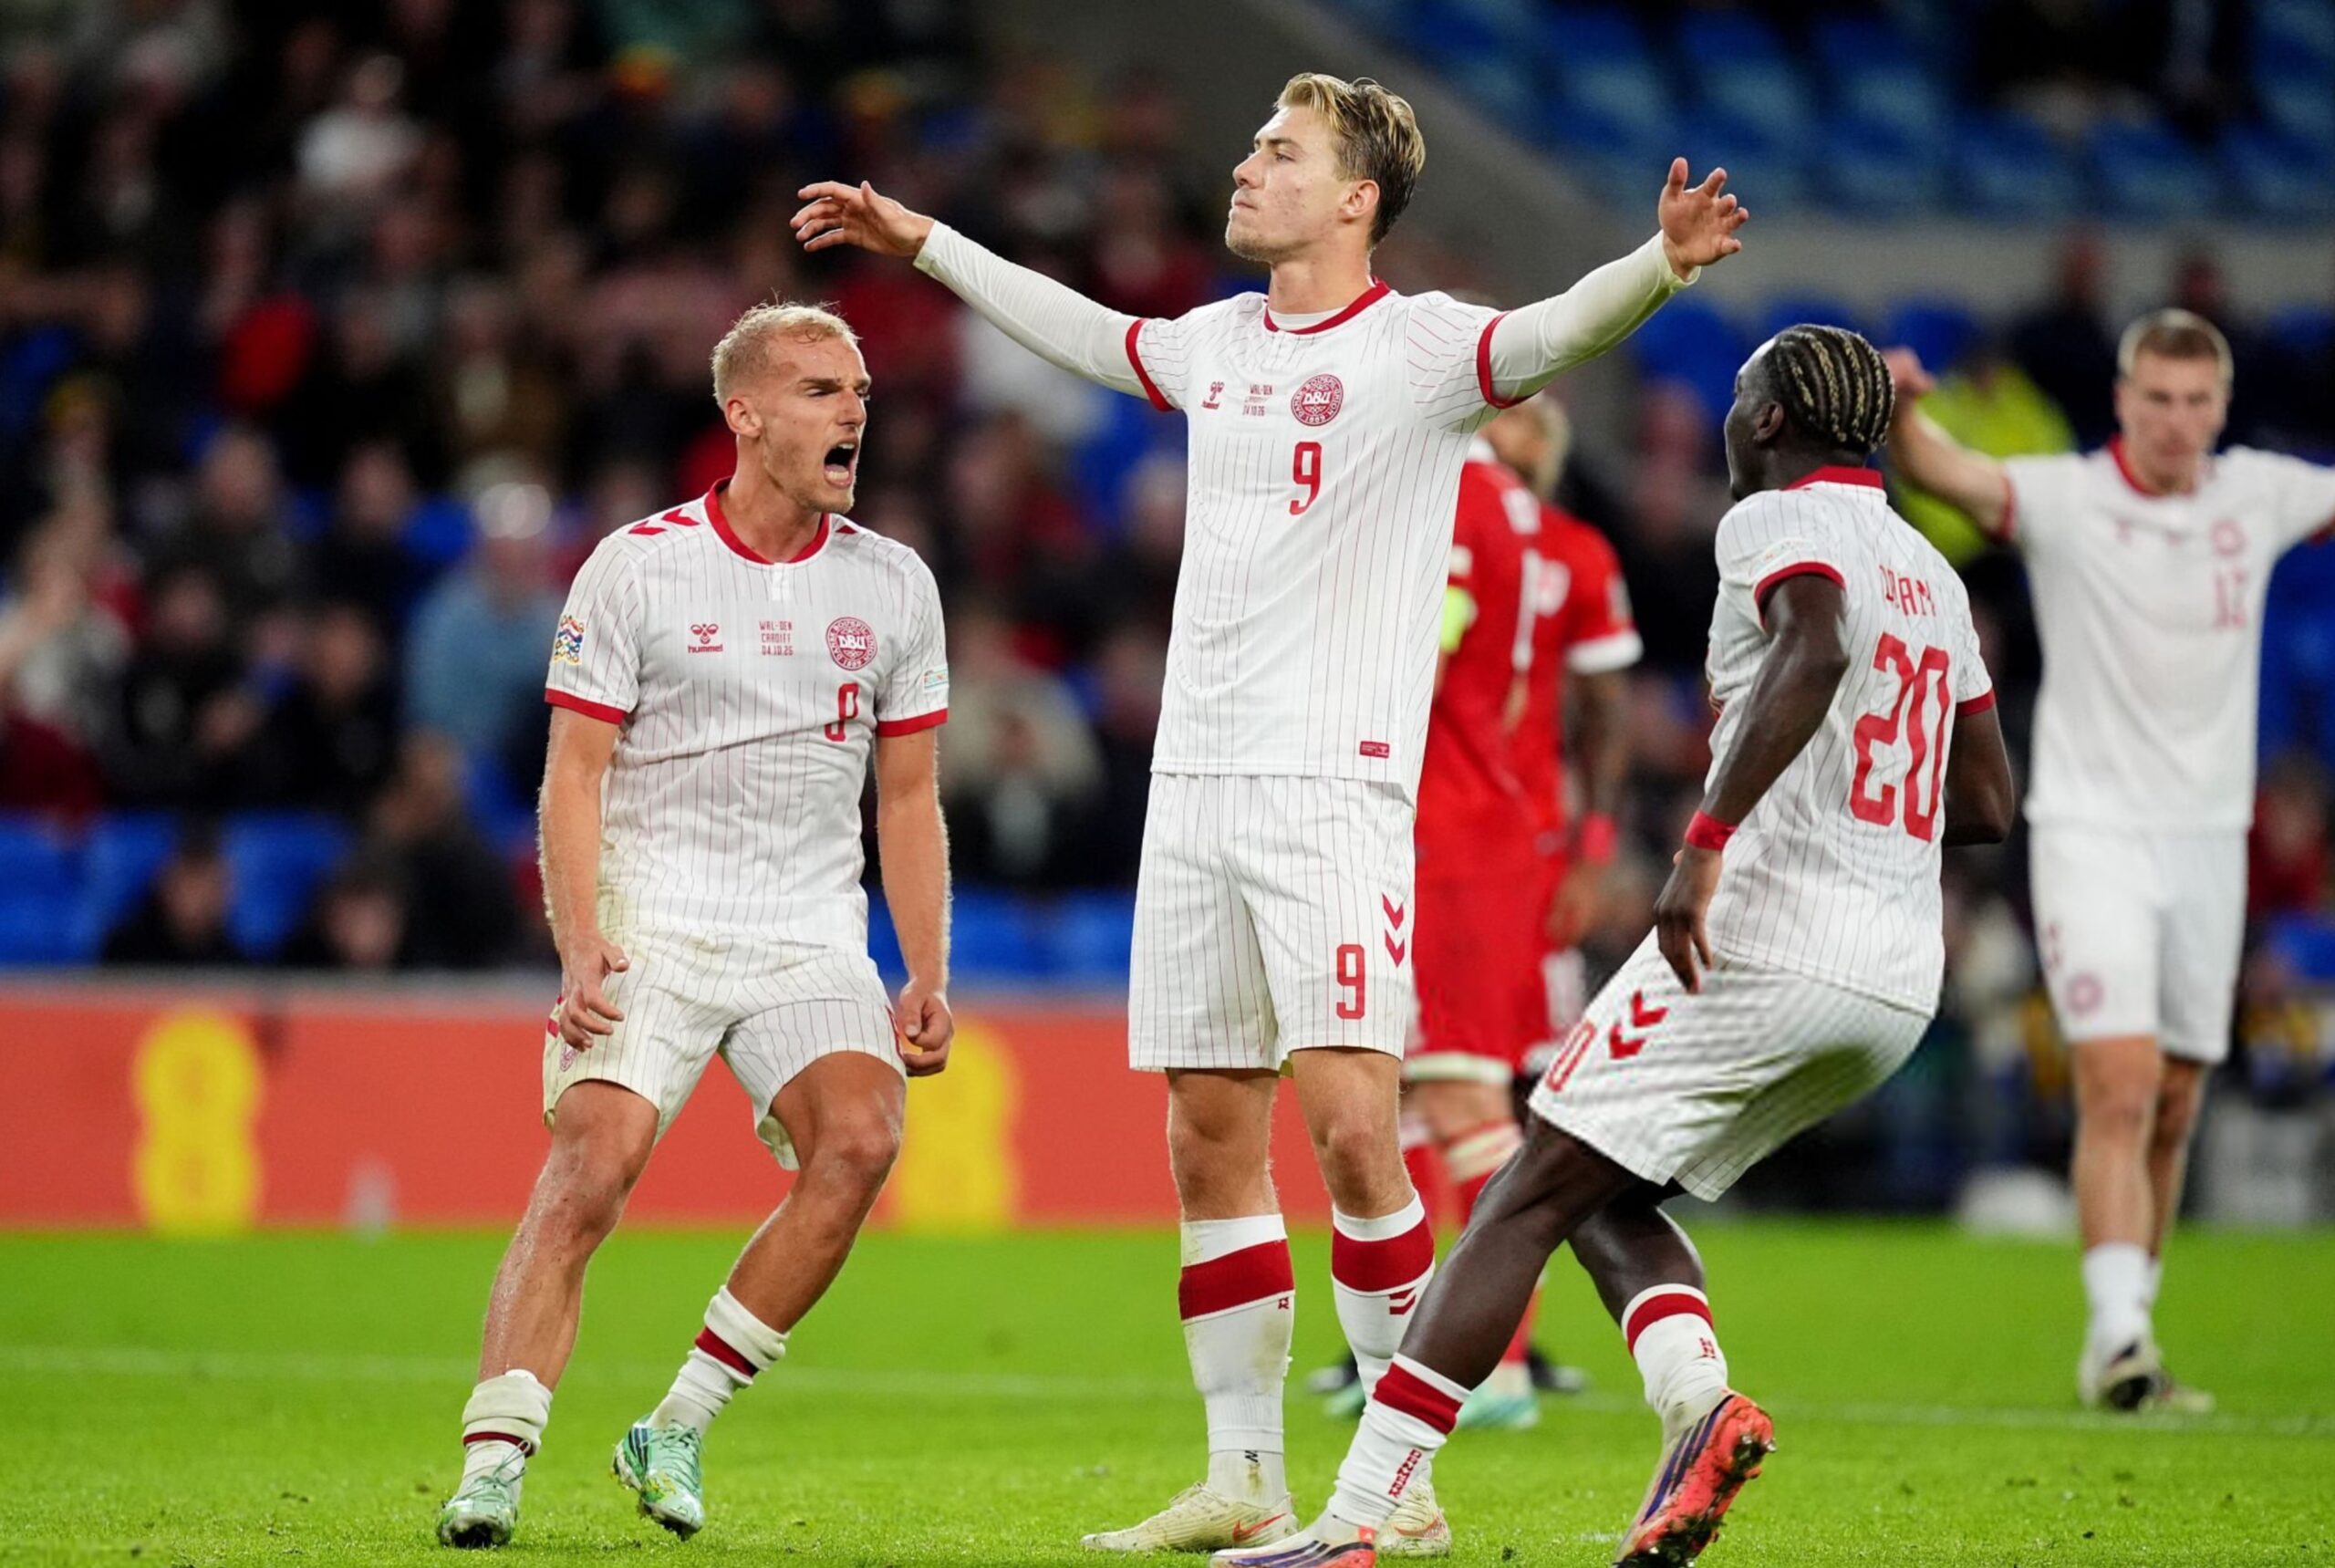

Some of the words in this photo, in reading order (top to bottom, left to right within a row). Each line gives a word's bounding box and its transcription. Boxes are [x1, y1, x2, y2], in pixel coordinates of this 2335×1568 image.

[1302, 391, 1332, 404] DBU
[1289, 441, 1323, 515] 9
[759, 620, 792, 631] WAL-DEN
[688, 644, 723, 654] hummel
[838, 634, 867, 650] DBU
[1850, 631, 1950, 843] 20
[1335, 943, 1366, 1021] 9
